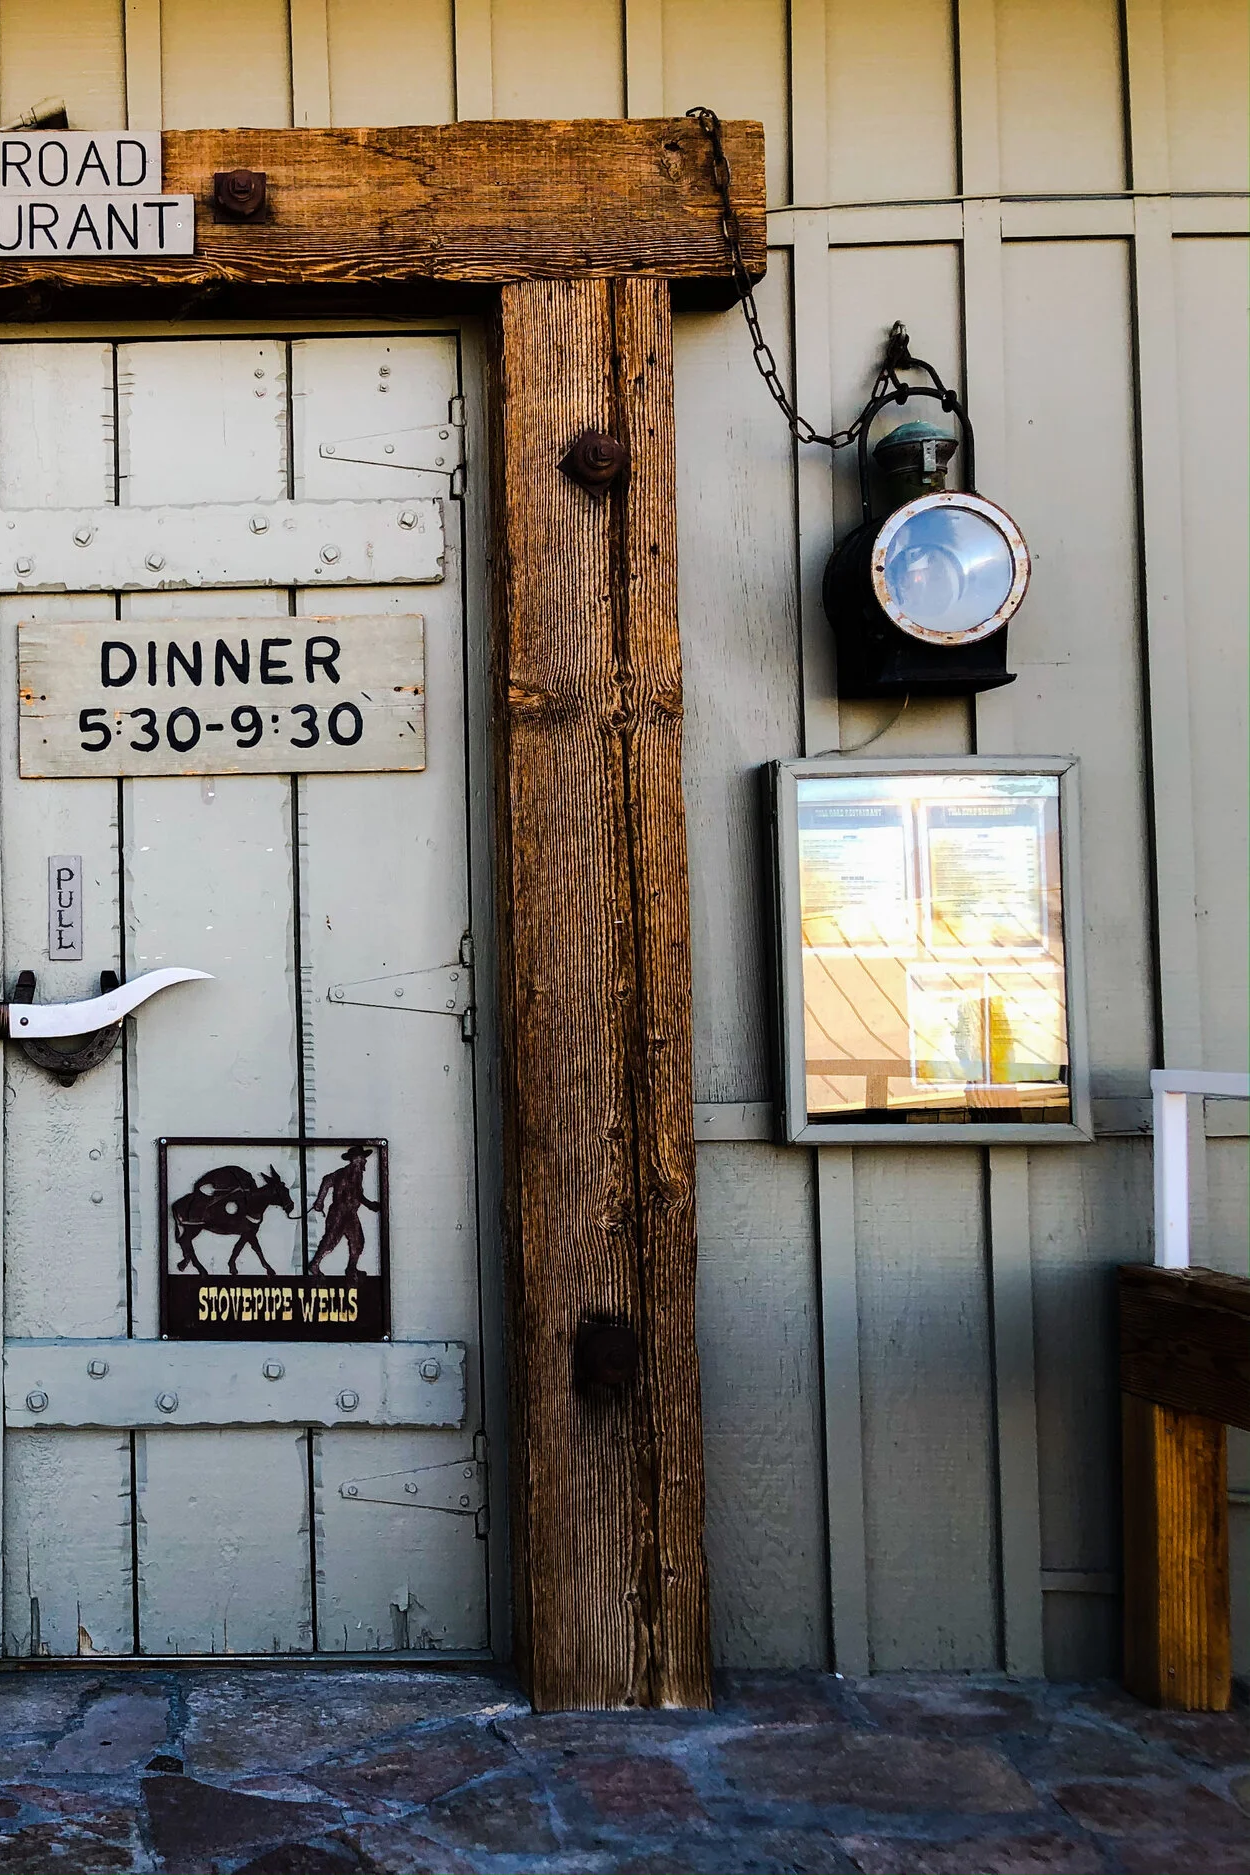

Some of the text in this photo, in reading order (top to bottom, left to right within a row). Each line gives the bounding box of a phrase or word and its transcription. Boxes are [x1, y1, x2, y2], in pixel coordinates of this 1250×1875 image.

[1, 139, 147, 188] ROAD
[100, 635, 341, 688] DINNER
[78, 701, 364, 753] 5:30-9:30
[55, 867, 76, 950] PULL
[198, 1286, 358, 1323] STOVEPIPE WELLS
